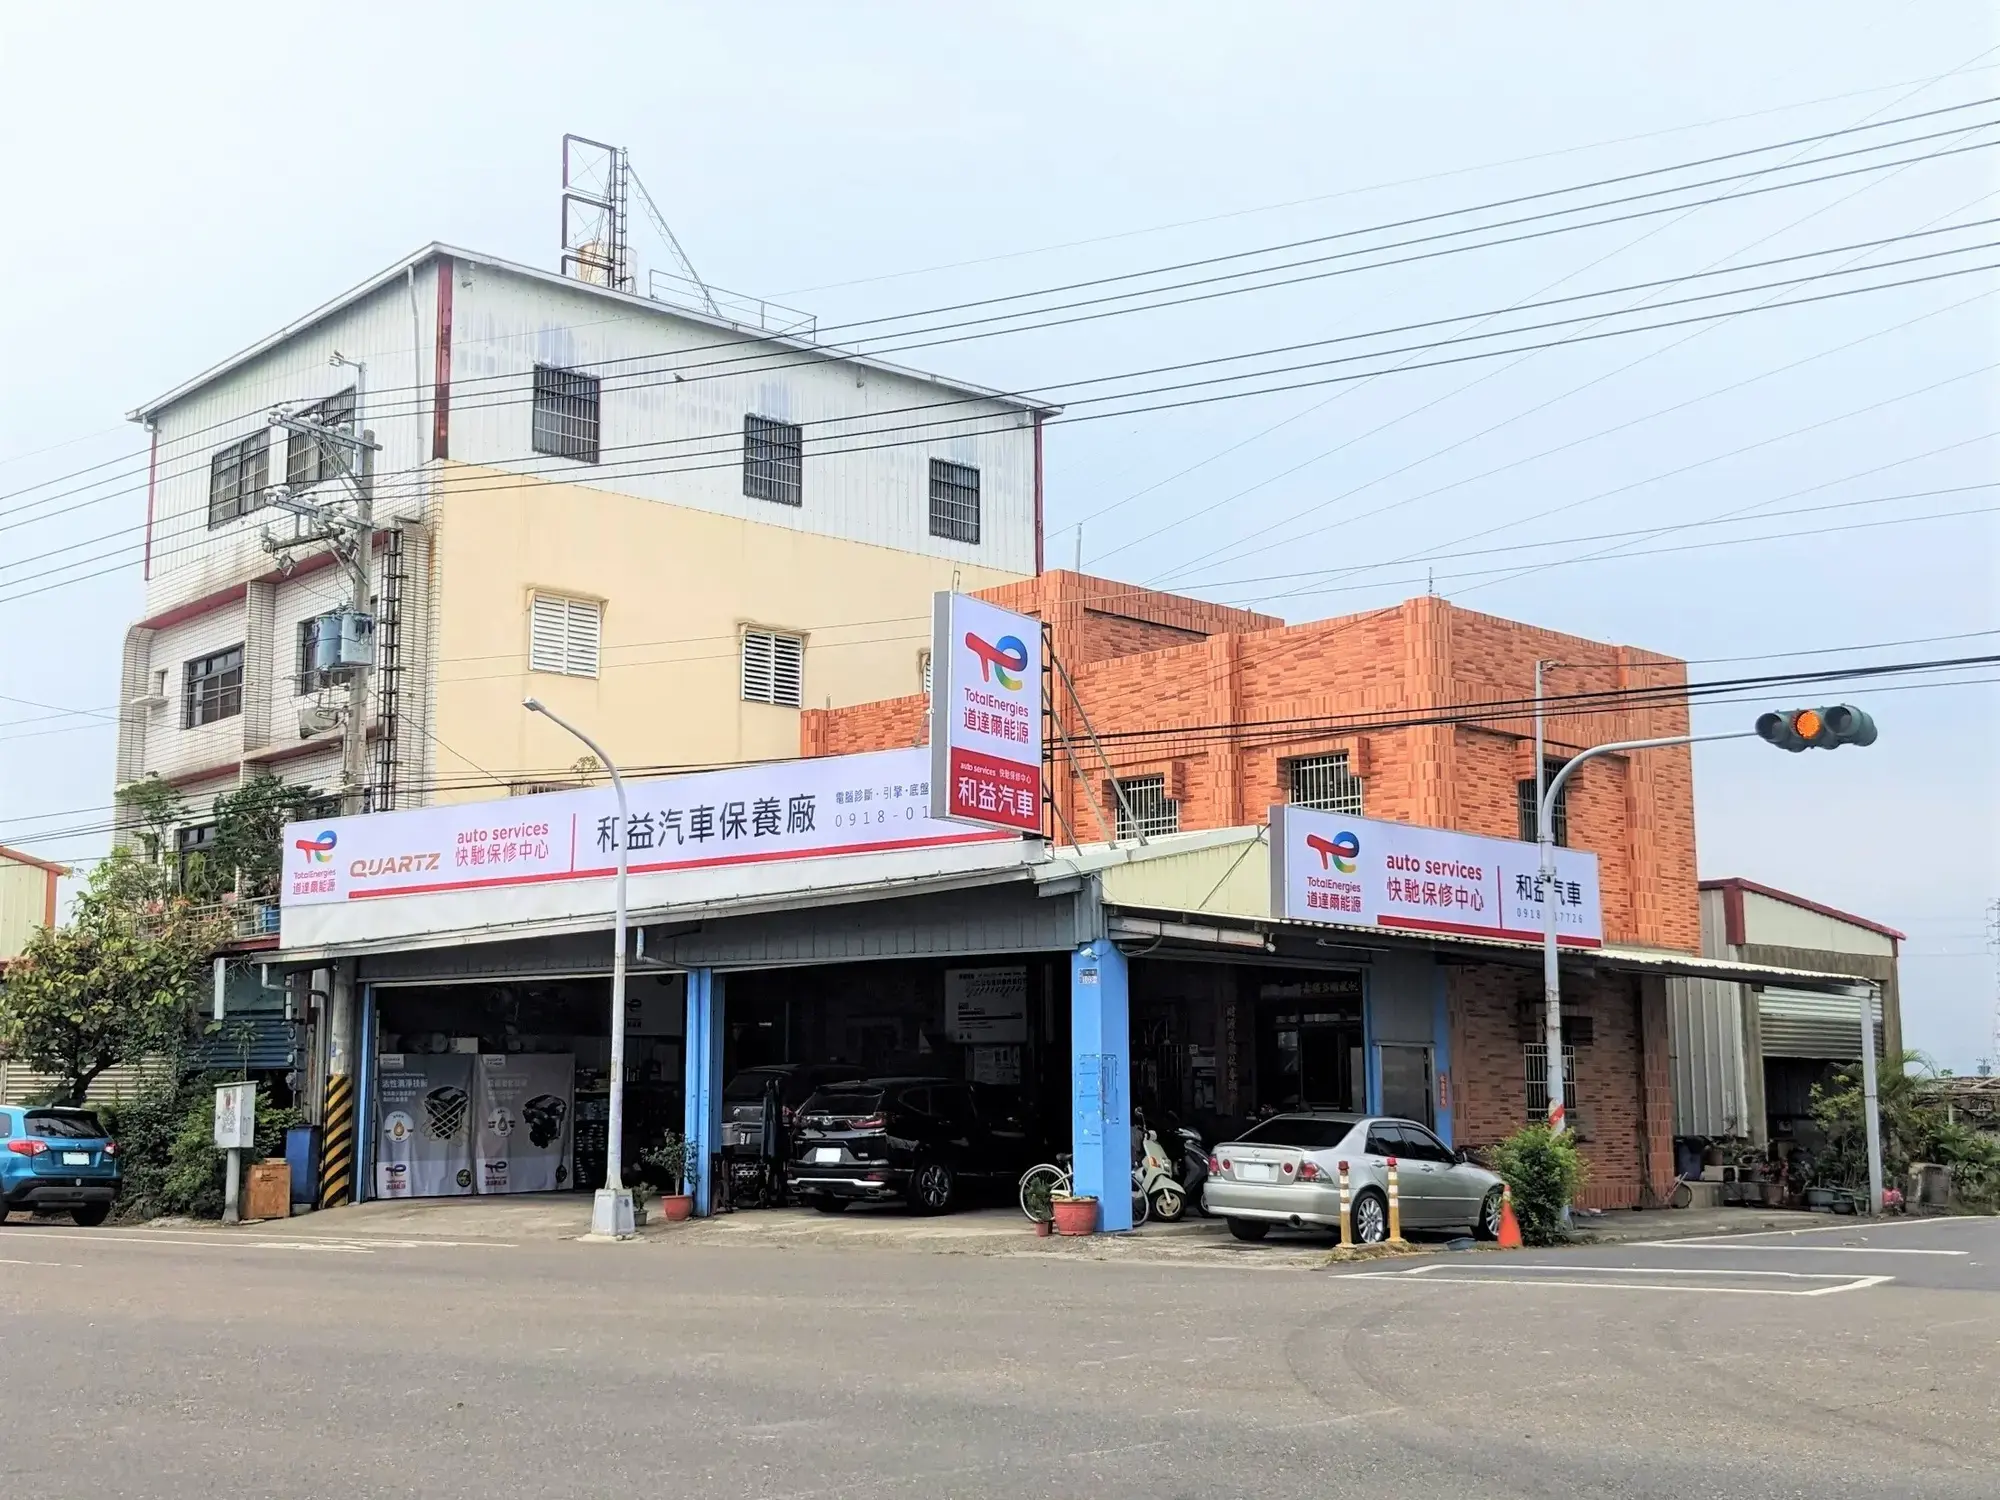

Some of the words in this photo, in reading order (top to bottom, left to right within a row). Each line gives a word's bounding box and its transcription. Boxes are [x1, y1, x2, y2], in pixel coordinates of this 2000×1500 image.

[964, 687, 1029, 718] TotalEnergies
[963, 706, 1029, 745] 道達爾能源
[960, 762, 974, 772] auto
[975, 765, 997, 777] services
[999, 768, 1032, 785] 快馳保修中心
[958, 776, 1035, 819] 和益汽車
[597, 793, 817, 853] 和益汽車保養廠
[835, 805, 929, 828] 0918-01
[457, 828, 488, 845] auto
[492, 822, 549, 841] services
[350, 853, 441, 878] QUARTZ
[454, 839, 550, 868] 快馳保修中心
[293, 867, 336, 880] TotalEnergies
[1386, 854, 1421, 873] auto
[1425, 860, 1482, 881] services
[292, 879, 336, 896] 道達爾能源
[1306, 875, 1361, 894] TotalEnergies
[1386, 876, 1485, 912] 快馳保修中心
[1306, 891, 1362, 913] 道達爾能源
